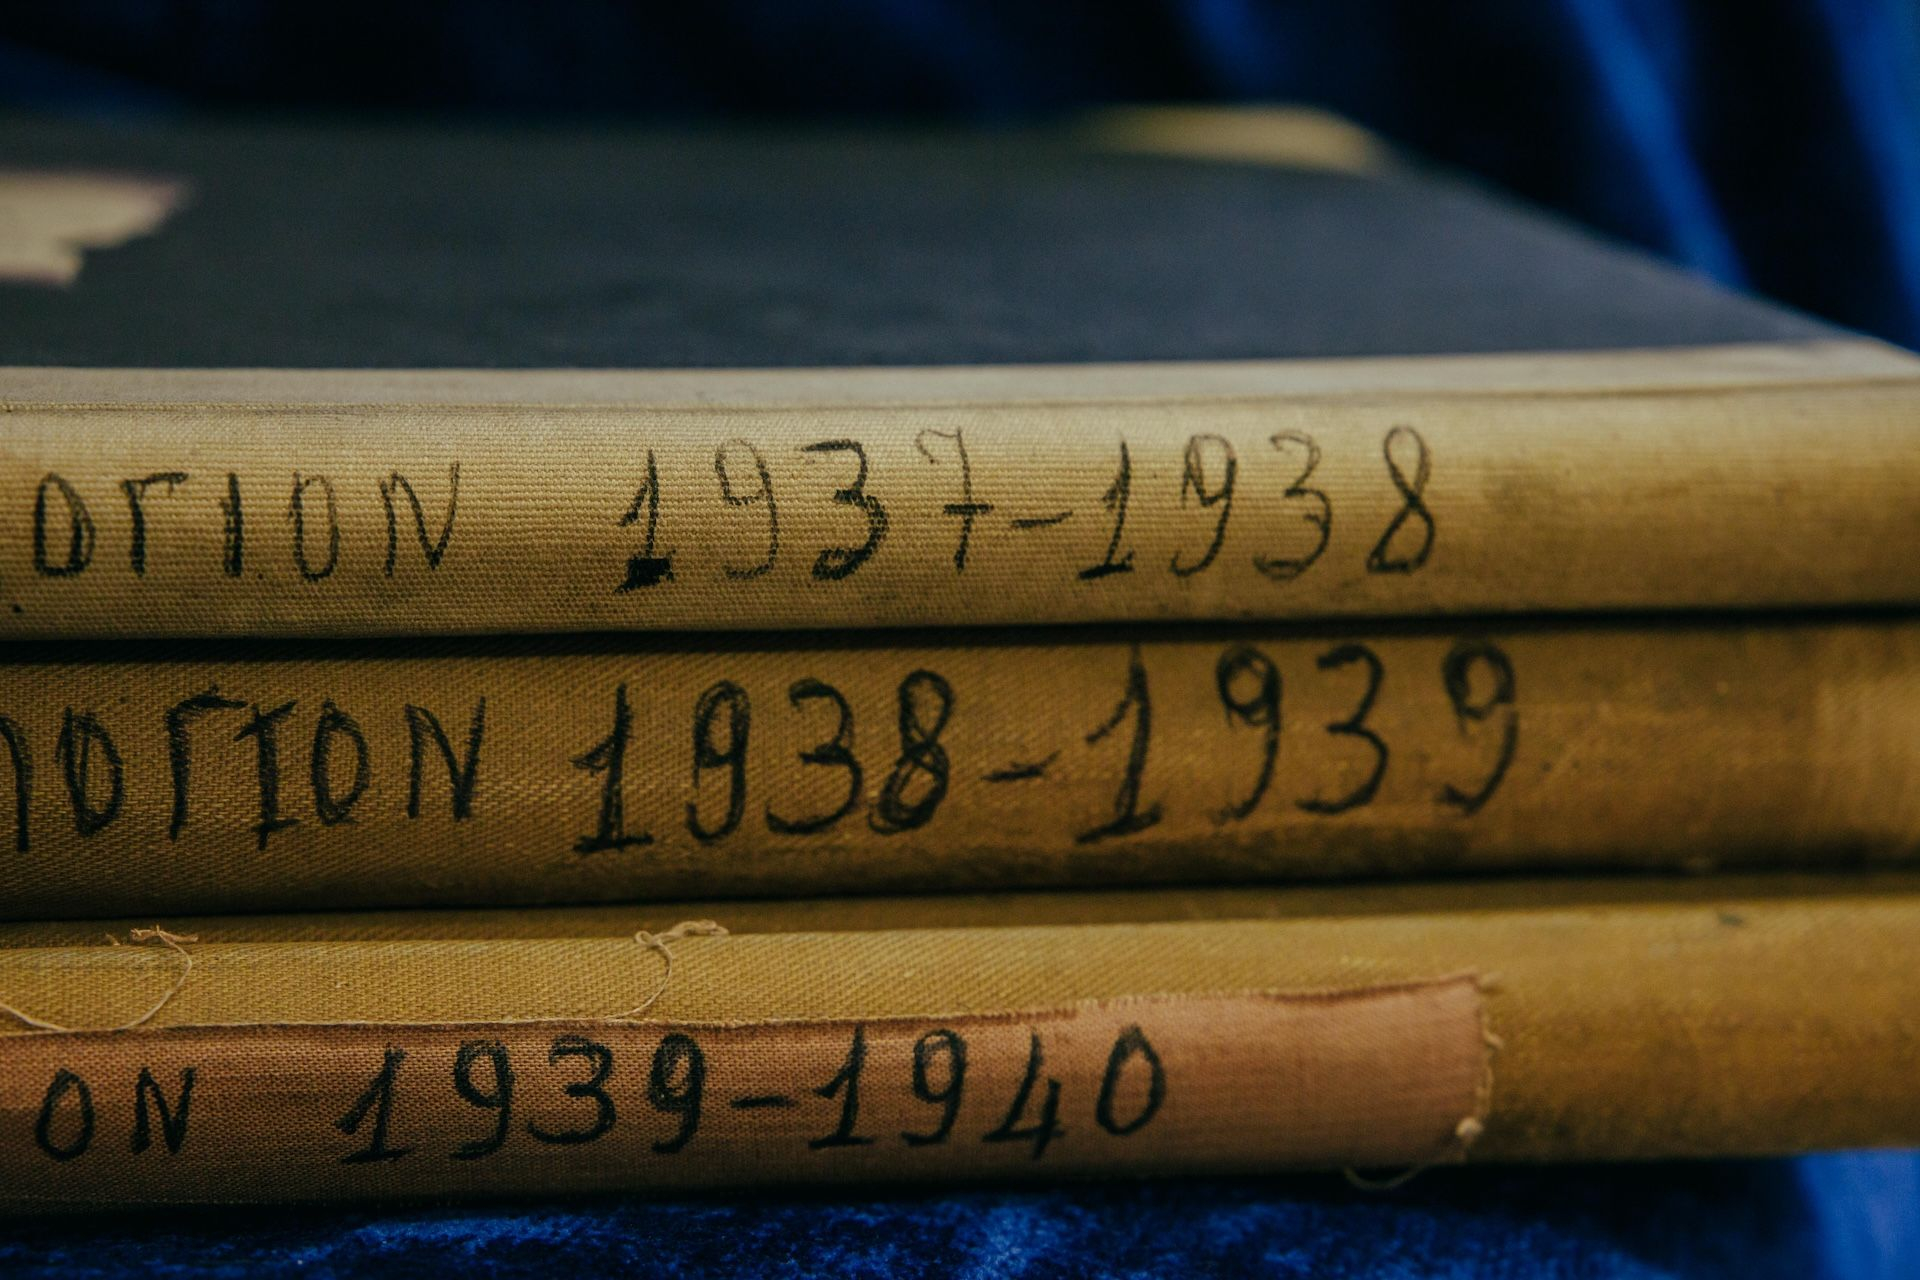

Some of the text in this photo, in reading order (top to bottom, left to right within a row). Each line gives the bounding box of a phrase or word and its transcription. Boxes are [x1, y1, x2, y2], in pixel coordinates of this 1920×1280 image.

[613, 425, 1435, 593] 1937-1938
[572, 642, 1518, 853] 1938-1939
[334, 1023, 1166, 1164] 1939-1940
